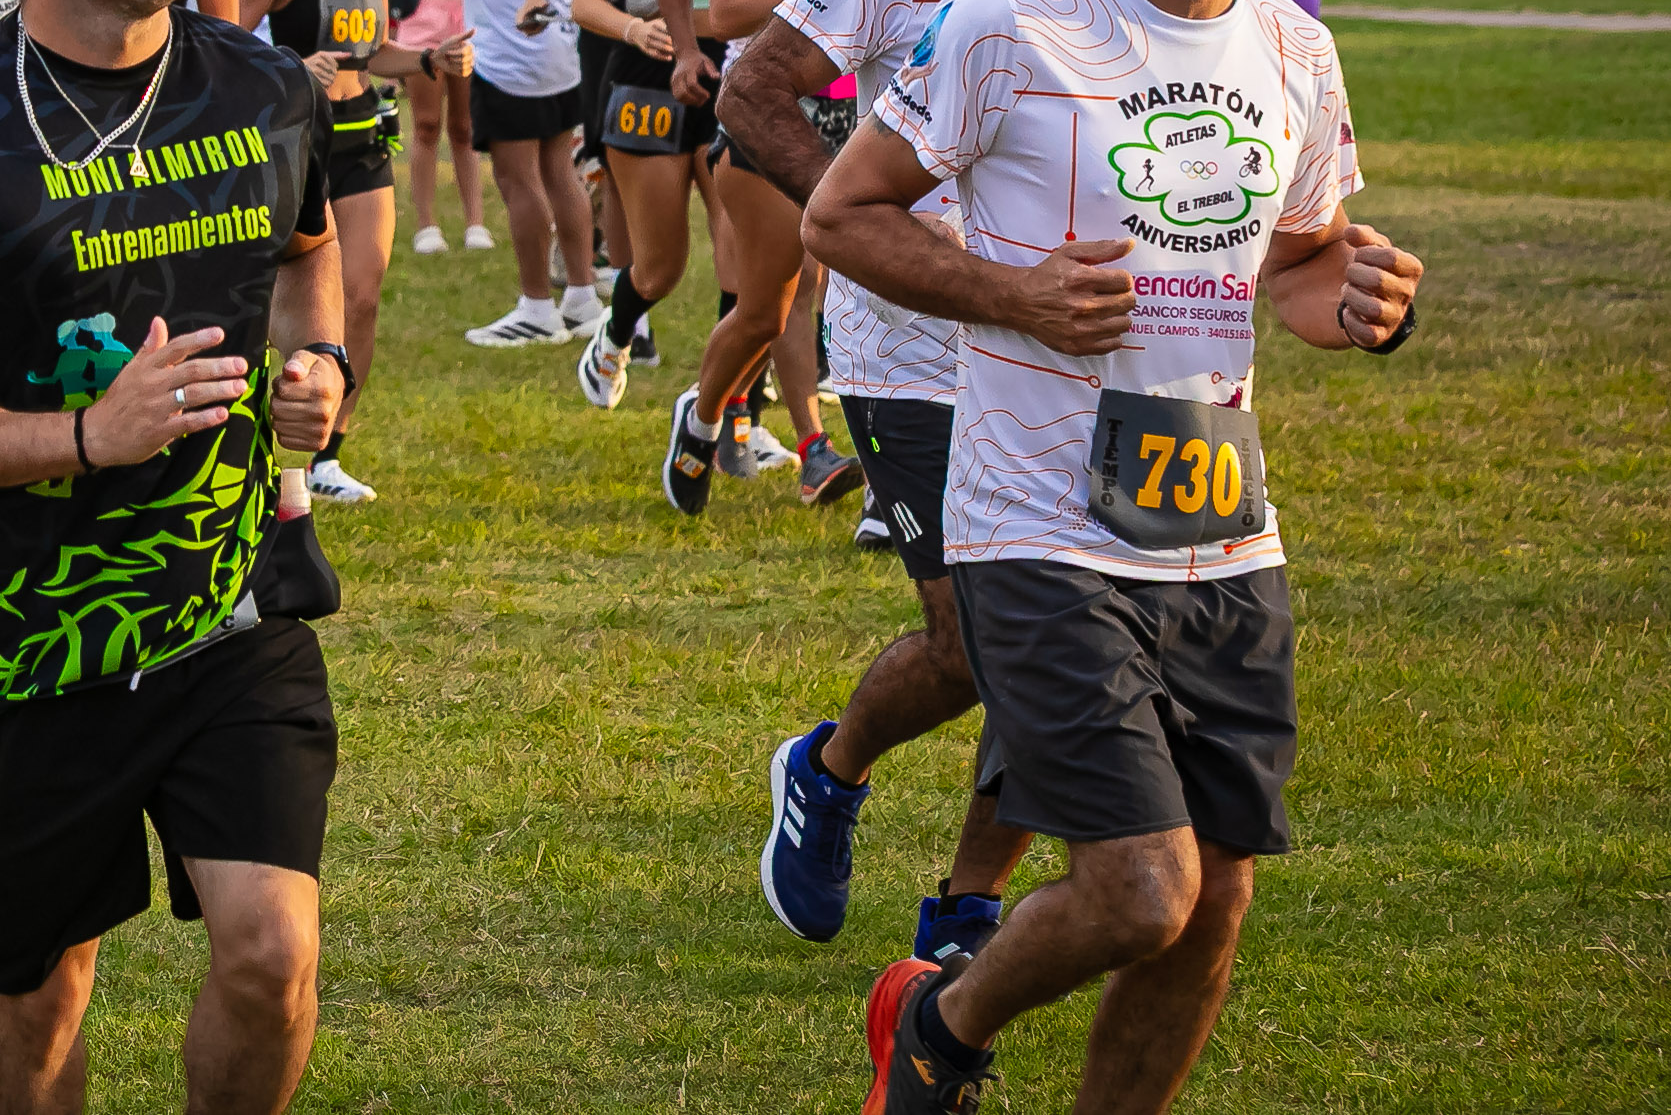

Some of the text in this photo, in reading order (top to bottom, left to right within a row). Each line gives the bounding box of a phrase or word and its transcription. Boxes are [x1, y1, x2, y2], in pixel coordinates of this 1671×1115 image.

[333, 8, 376, 43] 603
[620, 101, 672, 138] 610
[1118, 82, 1264, 129] MARATÓN
[1165, 123, 1217, 148] ATLETAS
[40, 155, 125, 200] MONI
[1177, 190, 1235, 214] EL TREBOL
[71, 205, 272, 272] Entrenamientos
[1120, 213, 1262, 254] ANIVERSARIO
[1131, 275, 1217, 299] ención
[1131, 305, 1248, 323] SANCOR SEGUROS
[1157, 324, 1200, 337] CAMPOS
[1100, 418, 1123, 507] TIEMPO
[1136, 433, 1242, 517] 730
